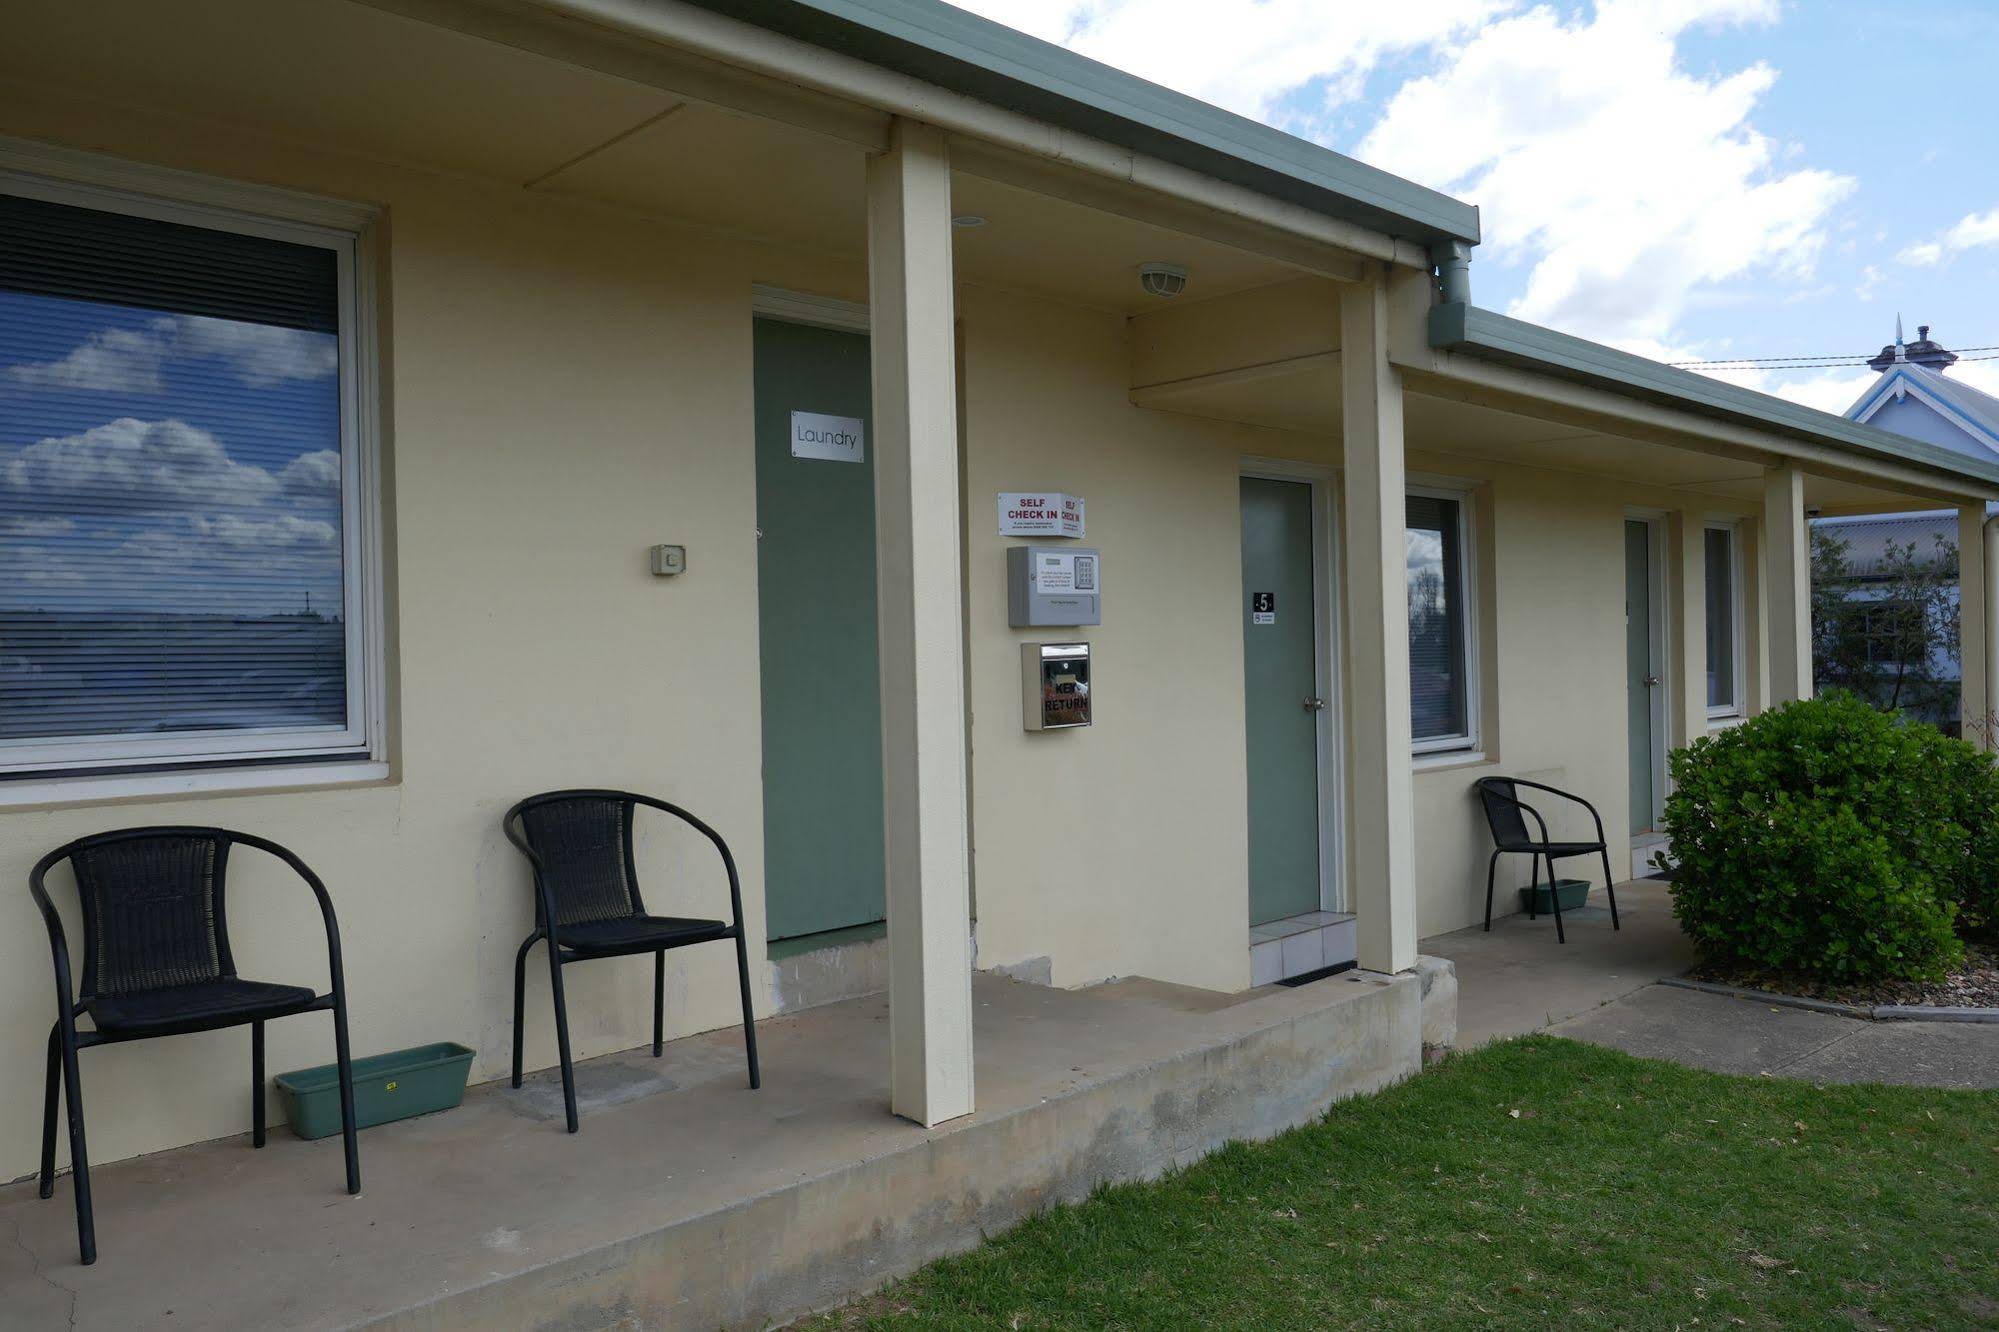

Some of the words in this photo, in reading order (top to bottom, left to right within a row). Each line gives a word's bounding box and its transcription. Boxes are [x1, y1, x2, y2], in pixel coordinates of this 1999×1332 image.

[798, 425, 857, 450] Laundry
[1019, 499, 1045, 508] SELF
[1007, 510, 1043, 519] CHECK
[1046, 510, 1058, 519] IN
[1260, 593, 1268, 611] 5
[1044, 697, 1088, 711] RETURN
